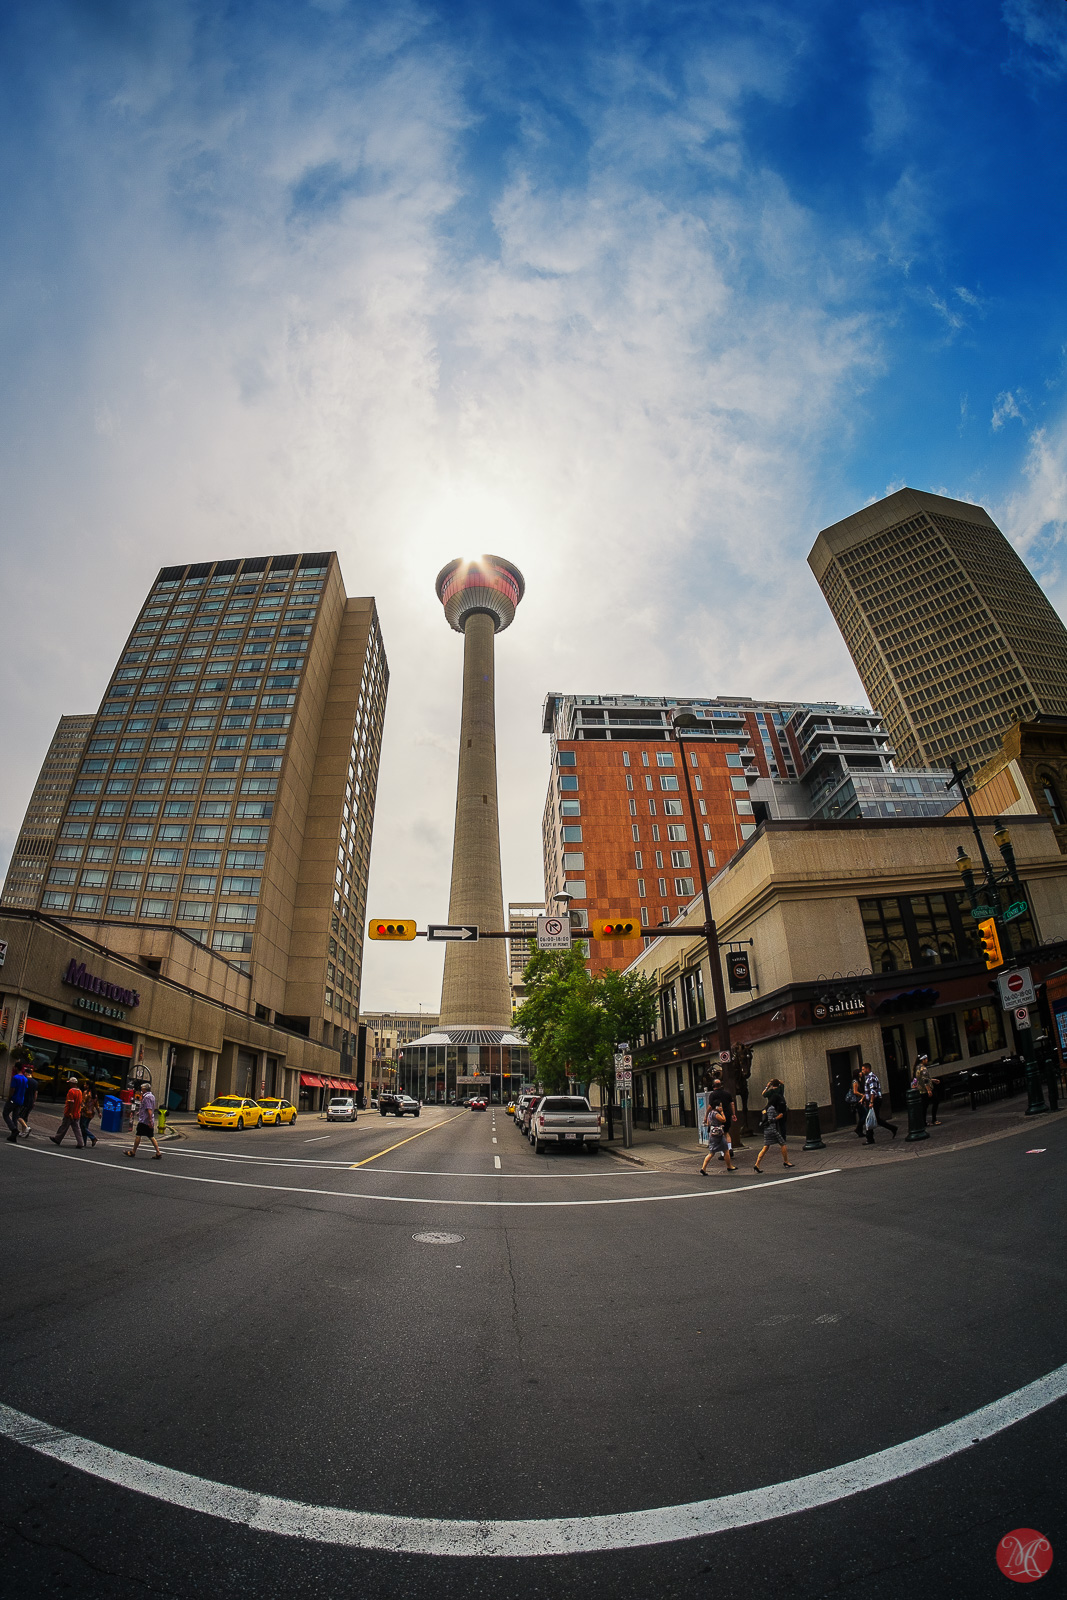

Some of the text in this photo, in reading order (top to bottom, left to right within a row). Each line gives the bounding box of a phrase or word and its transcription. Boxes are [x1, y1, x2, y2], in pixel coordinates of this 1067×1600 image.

[1006, 907, 1019, 918] CENTRE
[79, 997, 104, 1014] GRILL
[112, 1008, 126, 1021] BAR
[829, 999, 865, 1013] saltlik
